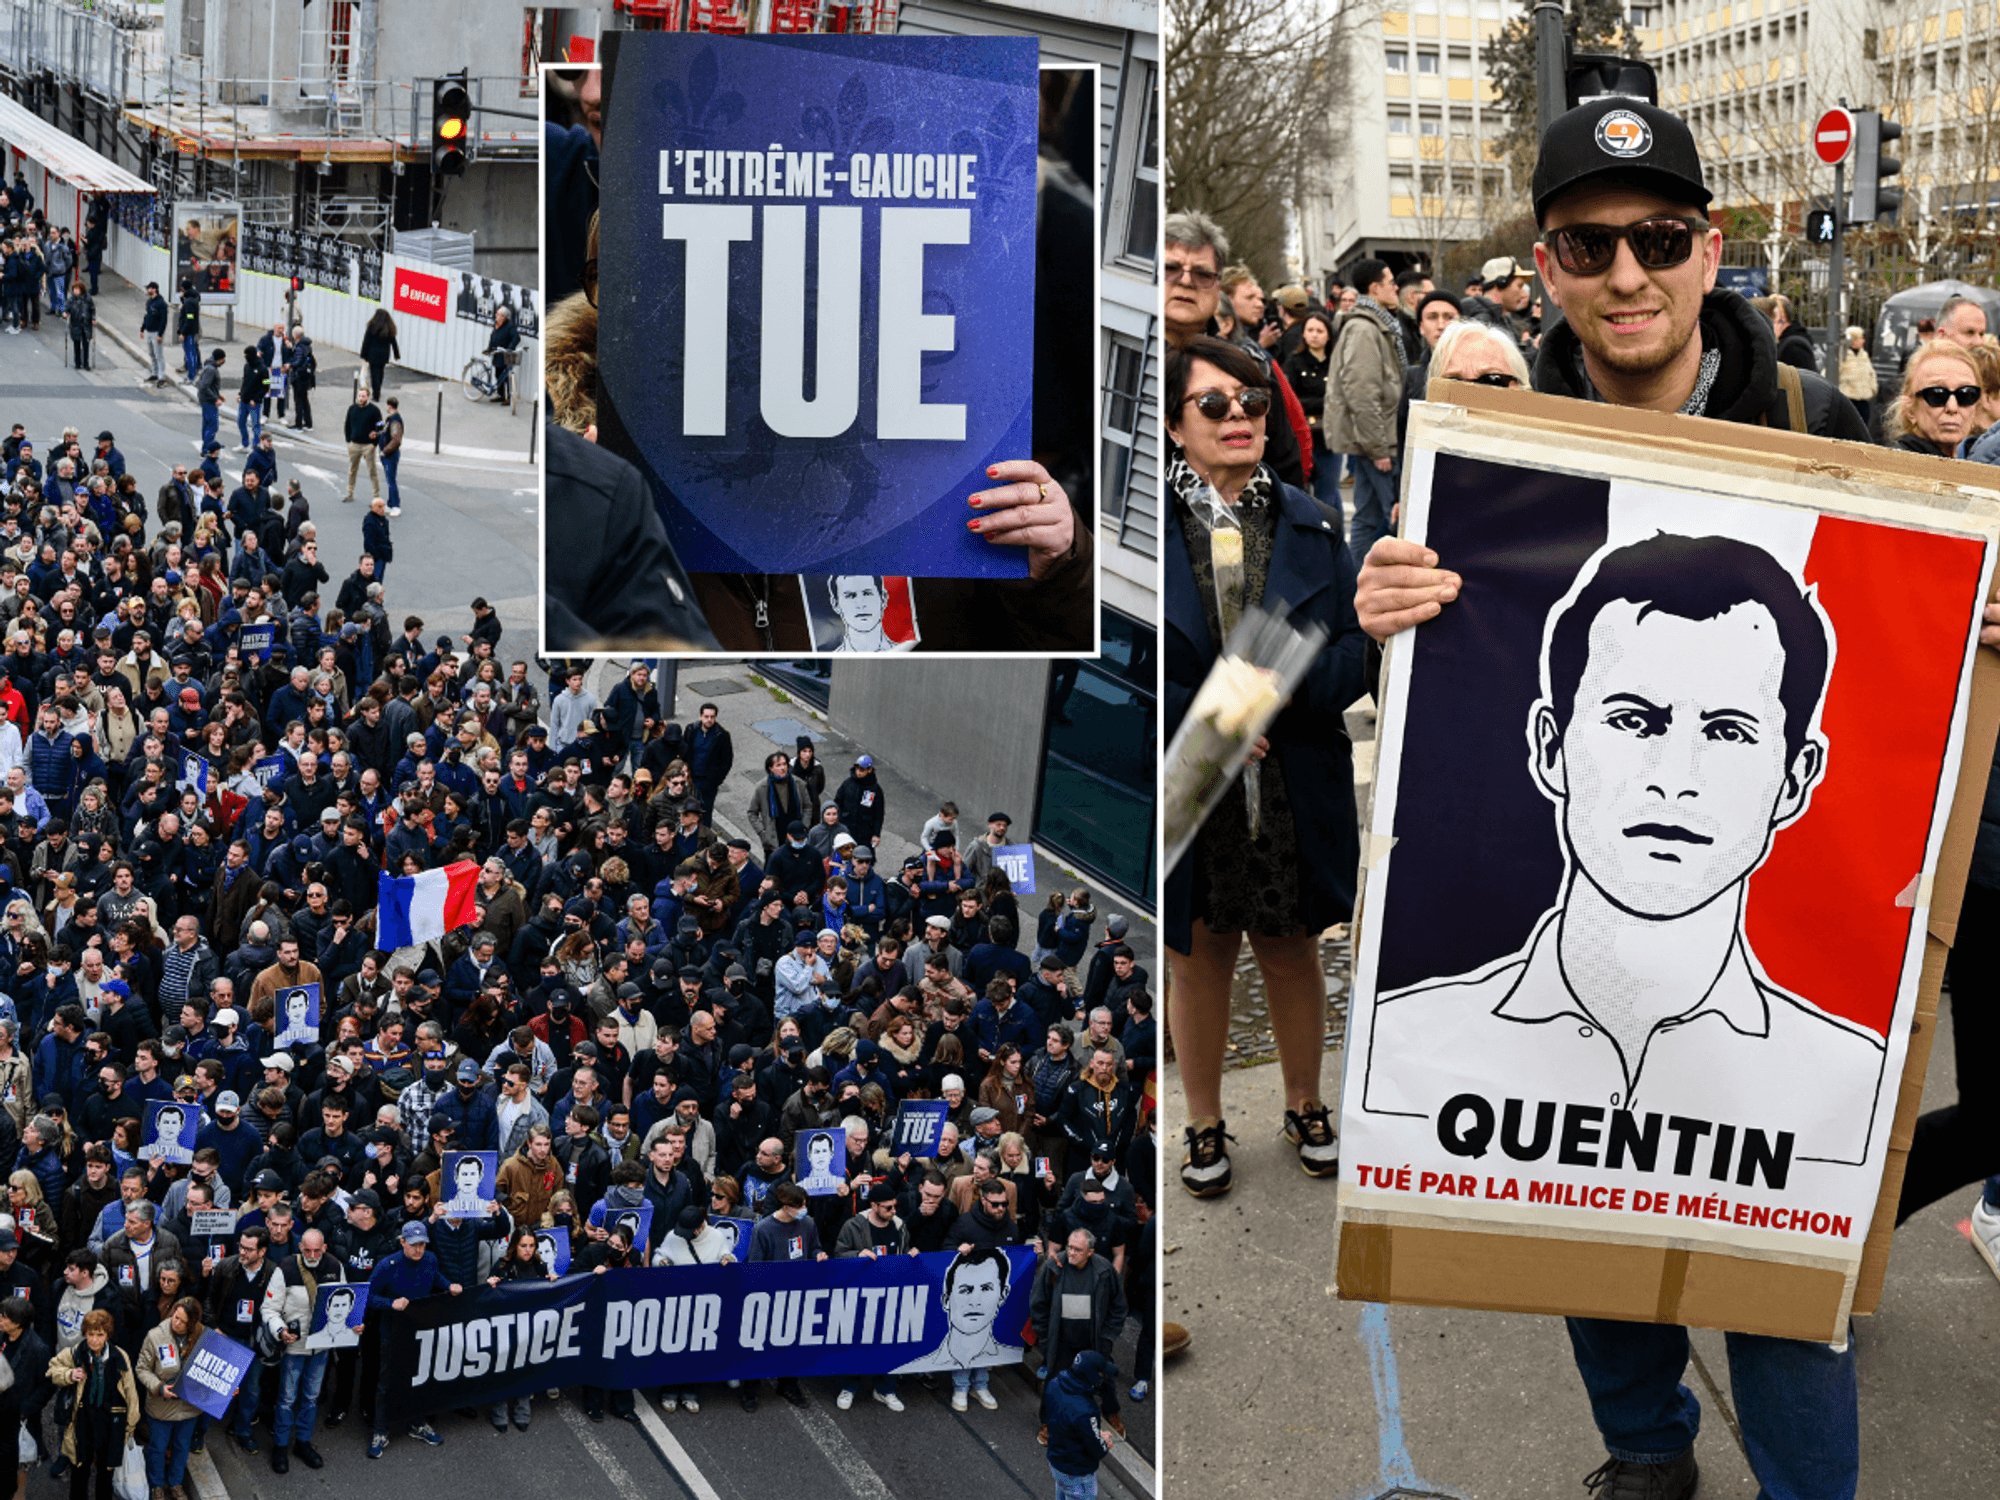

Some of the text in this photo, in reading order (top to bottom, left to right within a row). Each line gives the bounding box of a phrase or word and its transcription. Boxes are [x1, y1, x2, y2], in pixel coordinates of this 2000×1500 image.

[658, 143, 978, 200] L'EXTRÊME-GAUCHE
[663, 203, 971, 441] TUE
[997, 858, 1030, 883] TUE
[900, 1118, 940, 1144] TUE
[1437, 1093, 1796, 1190] QUENTIN
[1356, 1164, 1853, 1238] TUÉ PAR LA MILICE DE MÉLENCHON
[193, 1348, 240, 1384] ANTIFAS
[411, 1284, 929, 1387] JUSTICE POUR QUENTIN
